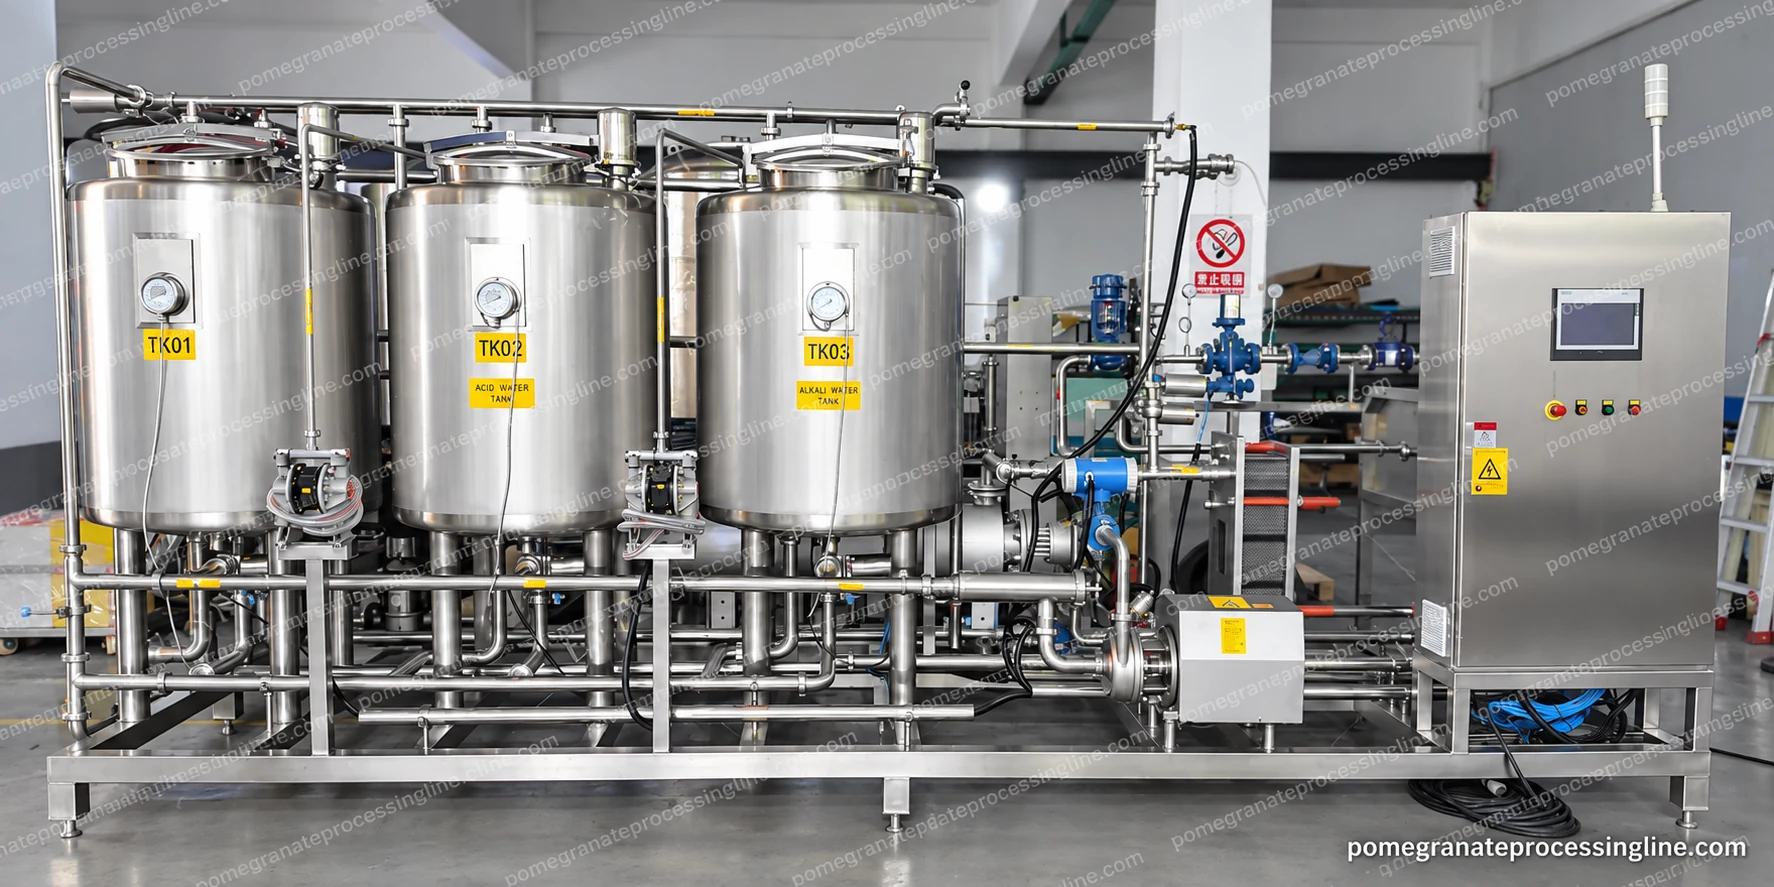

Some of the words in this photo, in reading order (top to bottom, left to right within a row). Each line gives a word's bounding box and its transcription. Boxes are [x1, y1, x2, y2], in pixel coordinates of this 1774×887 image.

[148, 337, 191, 354] TK01
[479, 340, 522, 357] TK02
[808, 343, 850, 360] TK03
[475, 384, 494, 392] ACID
[499, 384, 529, 392] WATER
[799, 386, 826, 394] ALKALI
[831, 386, 858, 394] WATER
[818, 397, 839, 405] TANK
